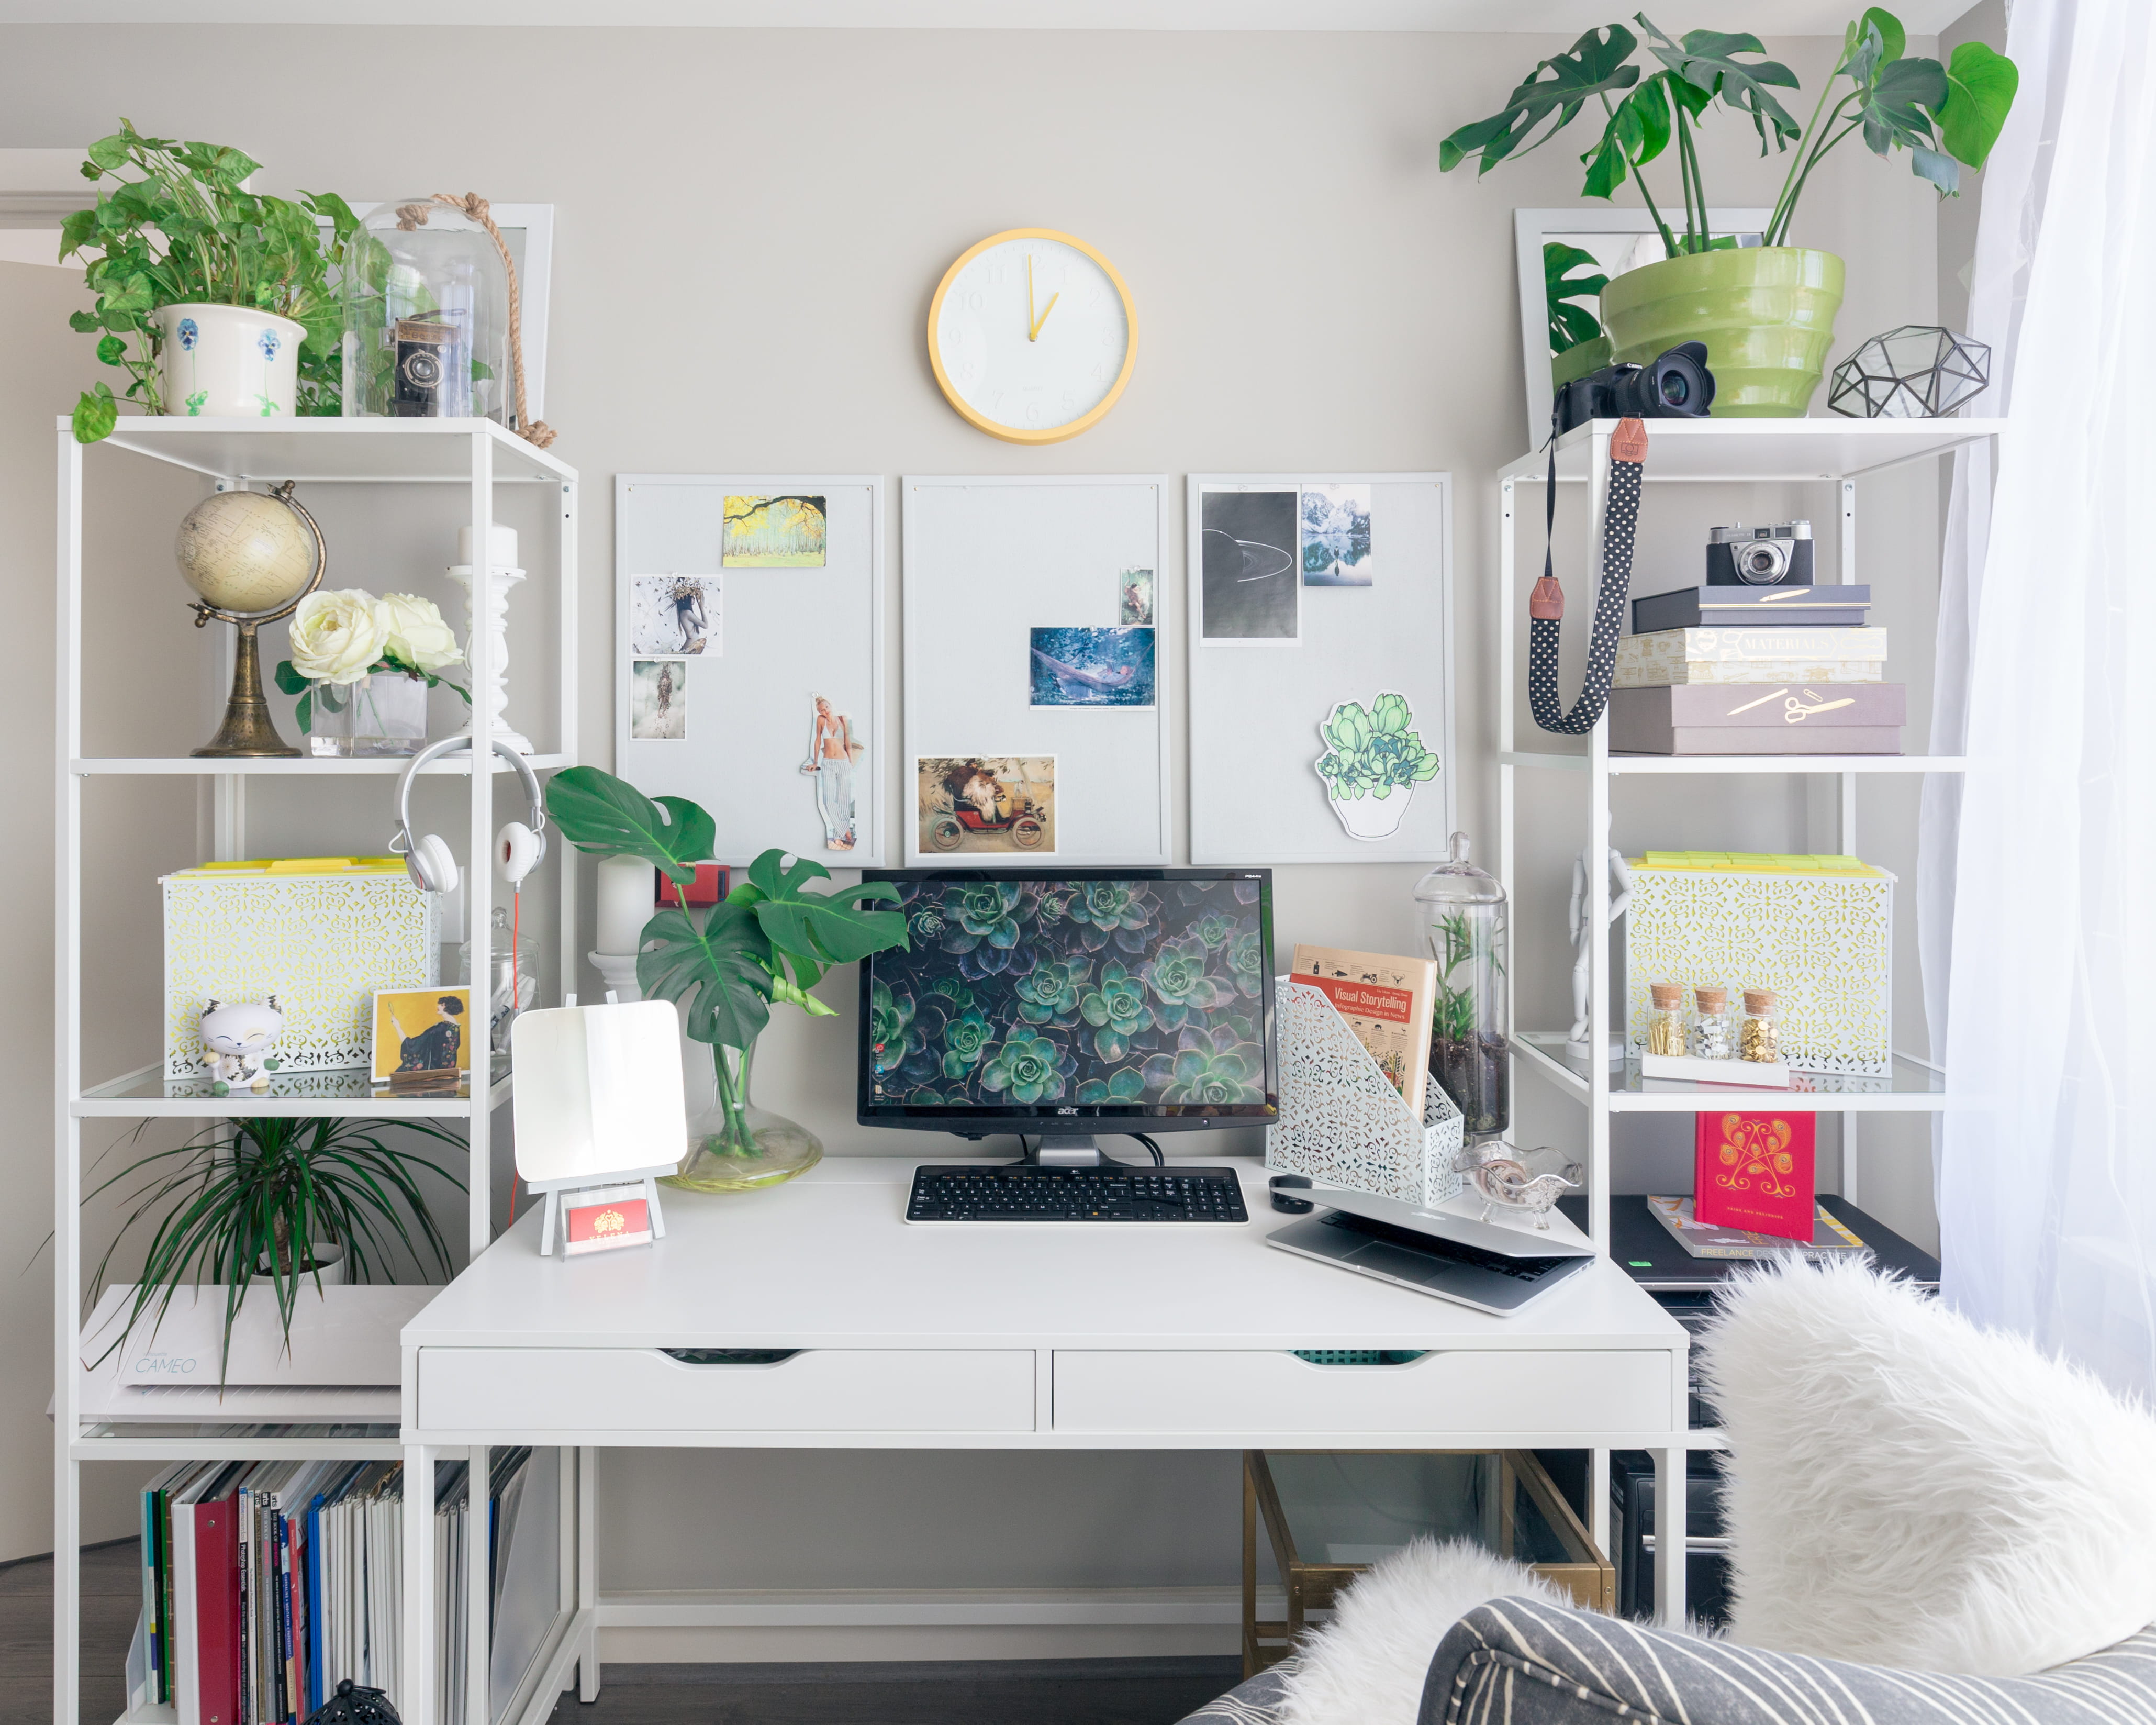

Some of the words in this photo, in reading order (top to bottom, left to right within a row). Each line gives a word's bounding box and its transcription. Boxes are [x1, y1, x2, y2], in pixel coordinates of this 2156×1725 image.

[959, 291, 984, 310] 10
[1089, 288, 1101, 307] 2
[949, 328, 963, 347] 9
[1102, 327, 1115, 347] 3
[960, 363, 974, 381] 8
[1091, 364, 1106, 382] 4
[992, 389, 1004, 409] 7
[1062, 391, 1076, 410] 5
[1026, 402, 1039, 422] 6
[1746, 638, 1829, 650] MATERIALS
[1335, 987, 1358, 1003] Visual
[1360, 992, 1406, 1012] Storytelling
[1335, 1003, 1364, 1012] Infographic
[1365, 1007, 1383, 1016] Design
[1701, 1248, 1753, 1257] FREELANCE
[136, 1358, 197, 1373] CAMEO
